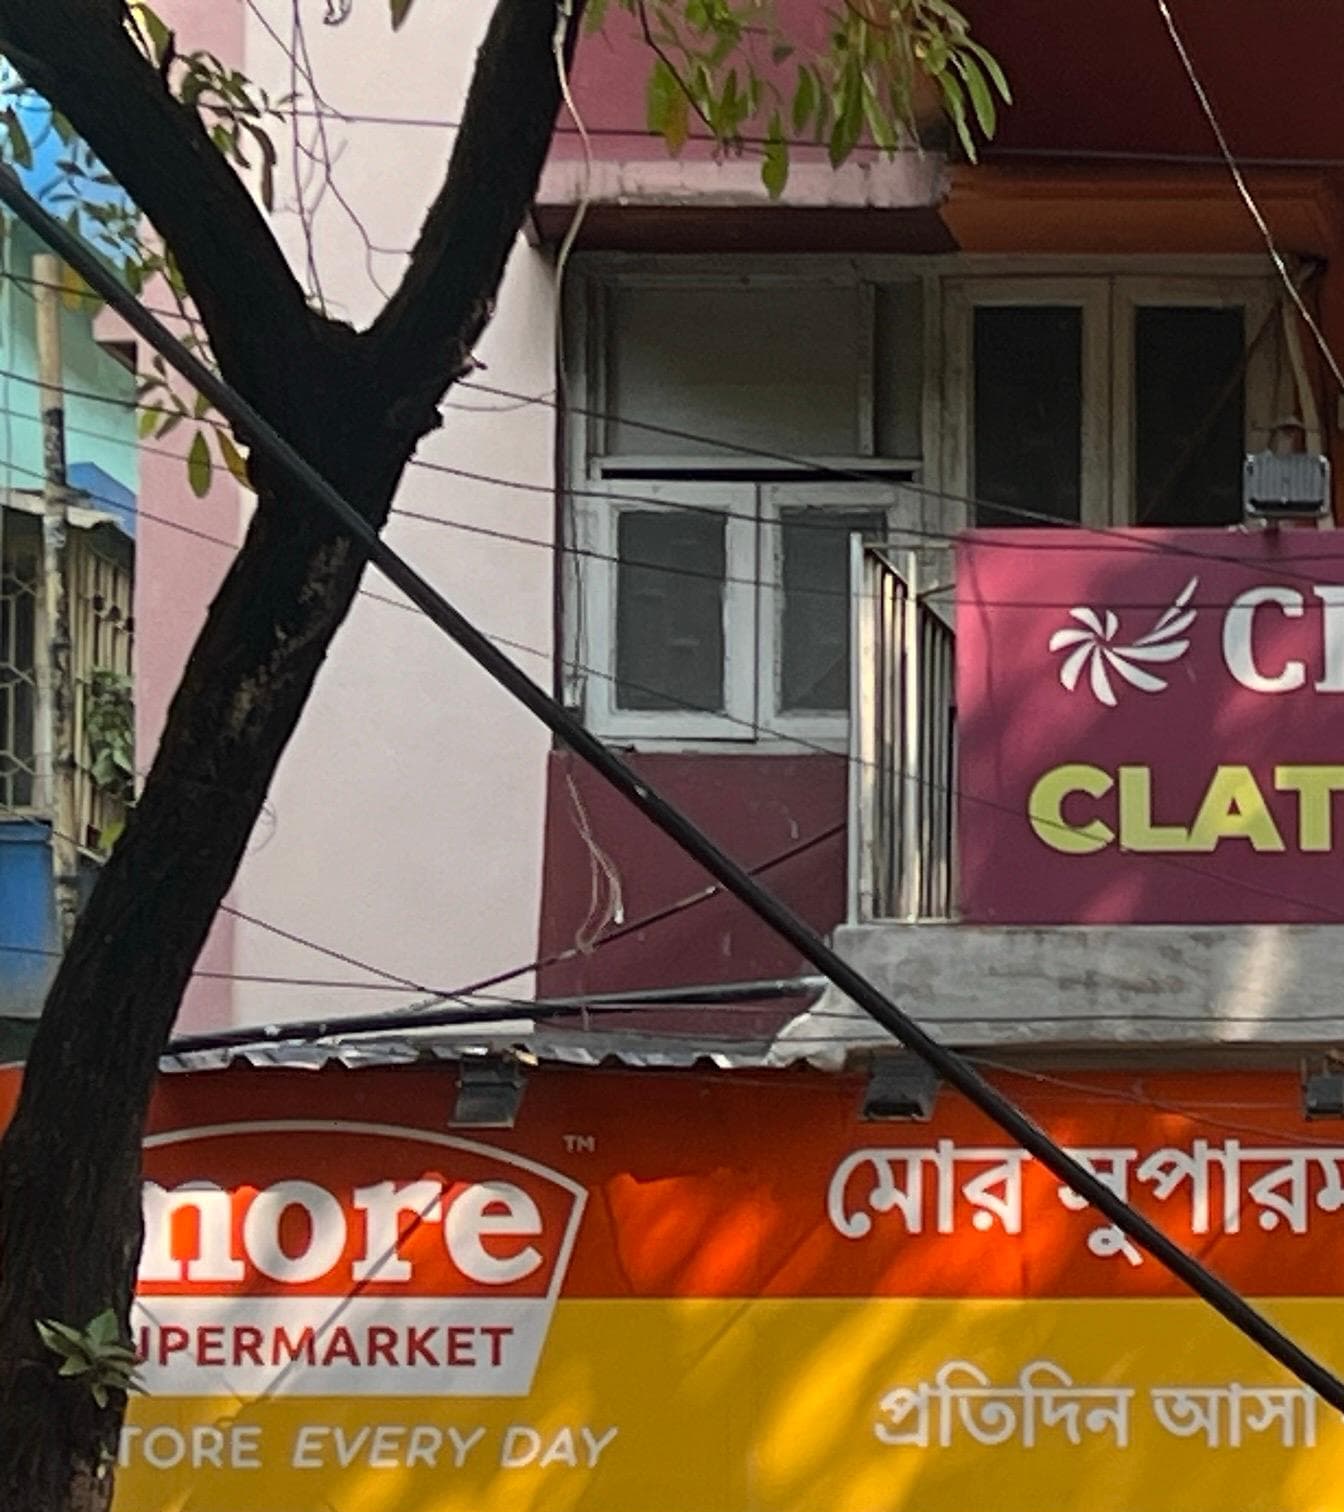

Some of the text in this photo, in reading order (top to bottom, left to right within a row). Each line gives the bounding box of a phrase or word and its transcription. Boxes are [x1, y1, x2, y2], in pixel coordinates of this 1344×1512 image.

[828, 1139, 1041, 1238] মোর
[134, 1325, 514, 1367] UPERMARKET
[874, 1357, 1133, 1448] প্রতিদিন
[1150, 1379, 1317, 1448] আসা
[118, 1426, 619, 1469] TORE EVERY DAY
